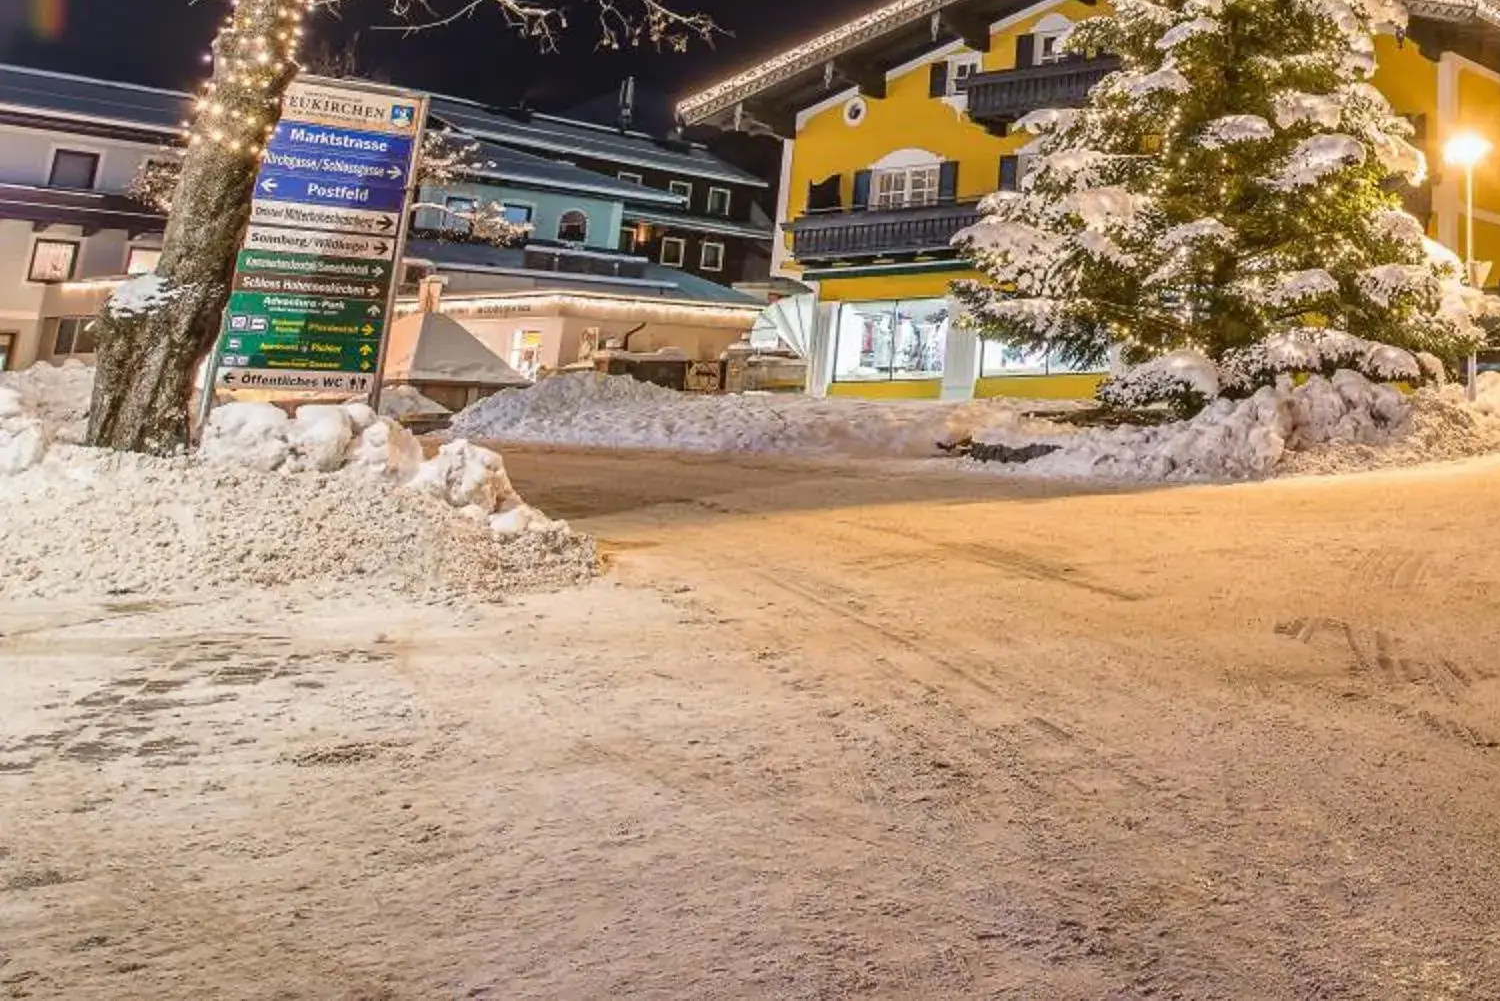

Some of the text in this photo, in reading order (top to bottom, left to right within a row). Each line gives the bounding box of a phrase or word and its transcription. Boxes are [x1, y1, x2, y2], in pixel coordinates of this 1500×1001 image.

[286, 95, 386, 119] EUKIRCHEN
[290, 128, 388, 152] Marktstrasse
[307, 182, 369, 202] Postfeld
[242, 276, 281, 288] Schloss
[241, 372, 343, 388] Öffentliches WC
